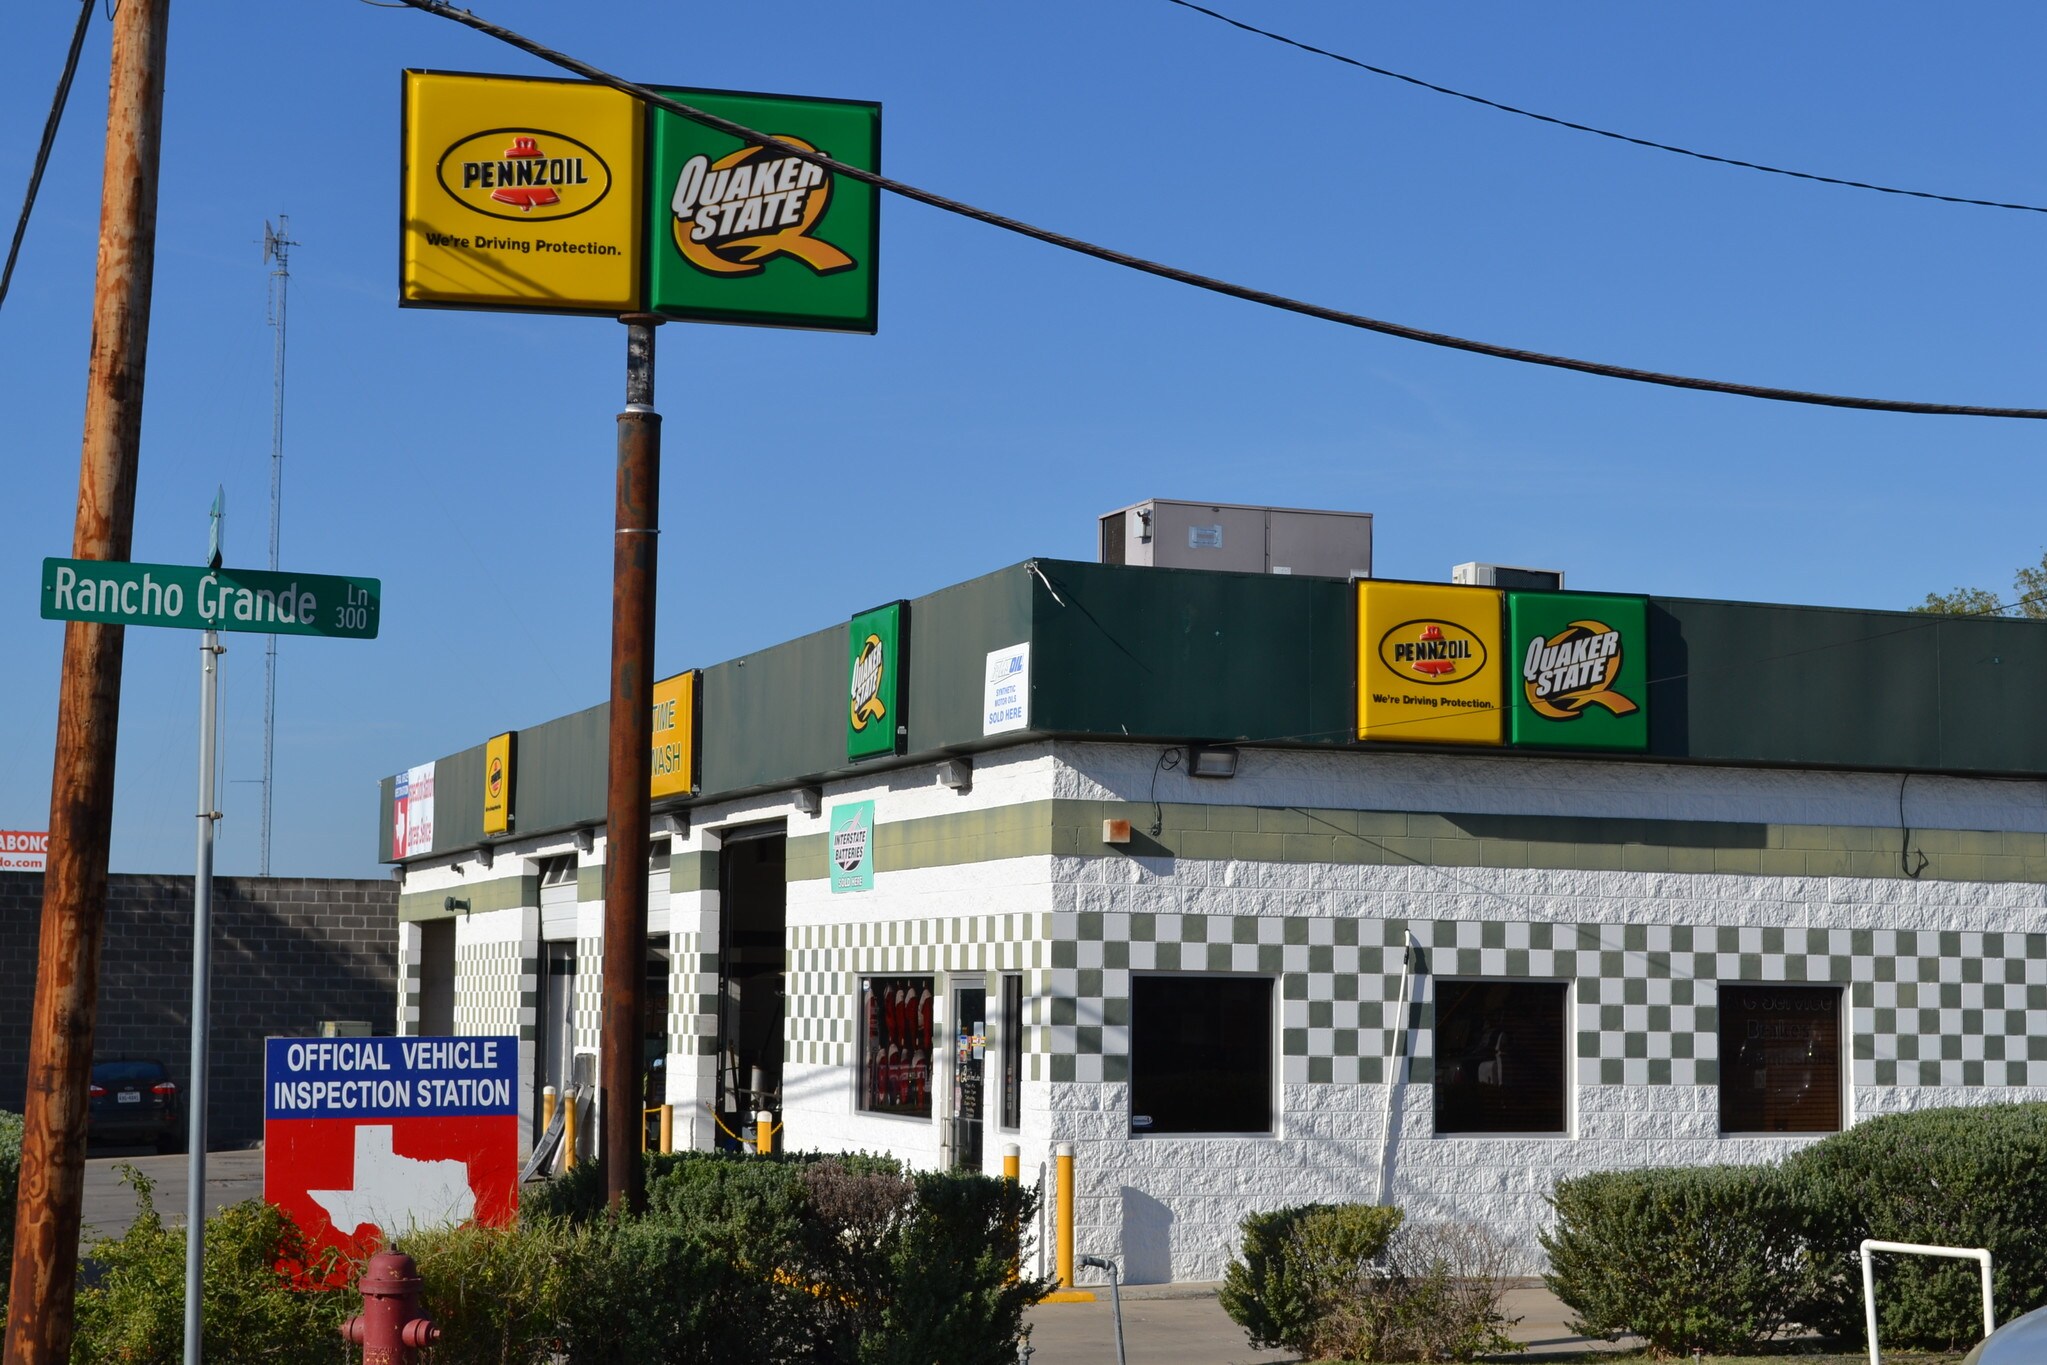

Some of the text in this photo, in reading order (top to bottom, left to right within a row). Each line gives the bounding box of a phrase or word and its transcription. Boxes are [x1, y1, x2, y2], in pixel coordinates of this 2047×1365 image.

[463, 157, 589, 190] PENNZOIL
[672, 154, 827, 217] QUAKER
[692, 189, 806, 241] STATE
[426, 233, 622, 256] We're Driving Protection.
[54, 566, 317, 625] Rancho Grande
[348, 584, 368, 606] Ln
[336, 607, 367, 630] 300
[1394, 639, 1472, 662] PENNZOIL
[1524, 631, 1619, 680] QUAKER
[851, 642, 882, 699] QUAKER
[1535, 657, 1606, 697] STATE
[854, 666, 879, 714] STATE
[994, 694, 1017, 707] MOTOR OILS
[996, 685, 1016, 696] SYNTHETIC
[1373, 694, 1494, 709] We're Driving Protection.
[988, 706, 1022, 724] SOLD HERE
[834, 830, 866, 846] INTERSTATE
[835, 846, 864, 861] BATTERIES
[838, 876, 863, 887] SOLD HERE
[287, 1042, 498, 1071] OFFICIAL VEHICLE
[274, 1079, 510, 1110] INSPECTION STATION
